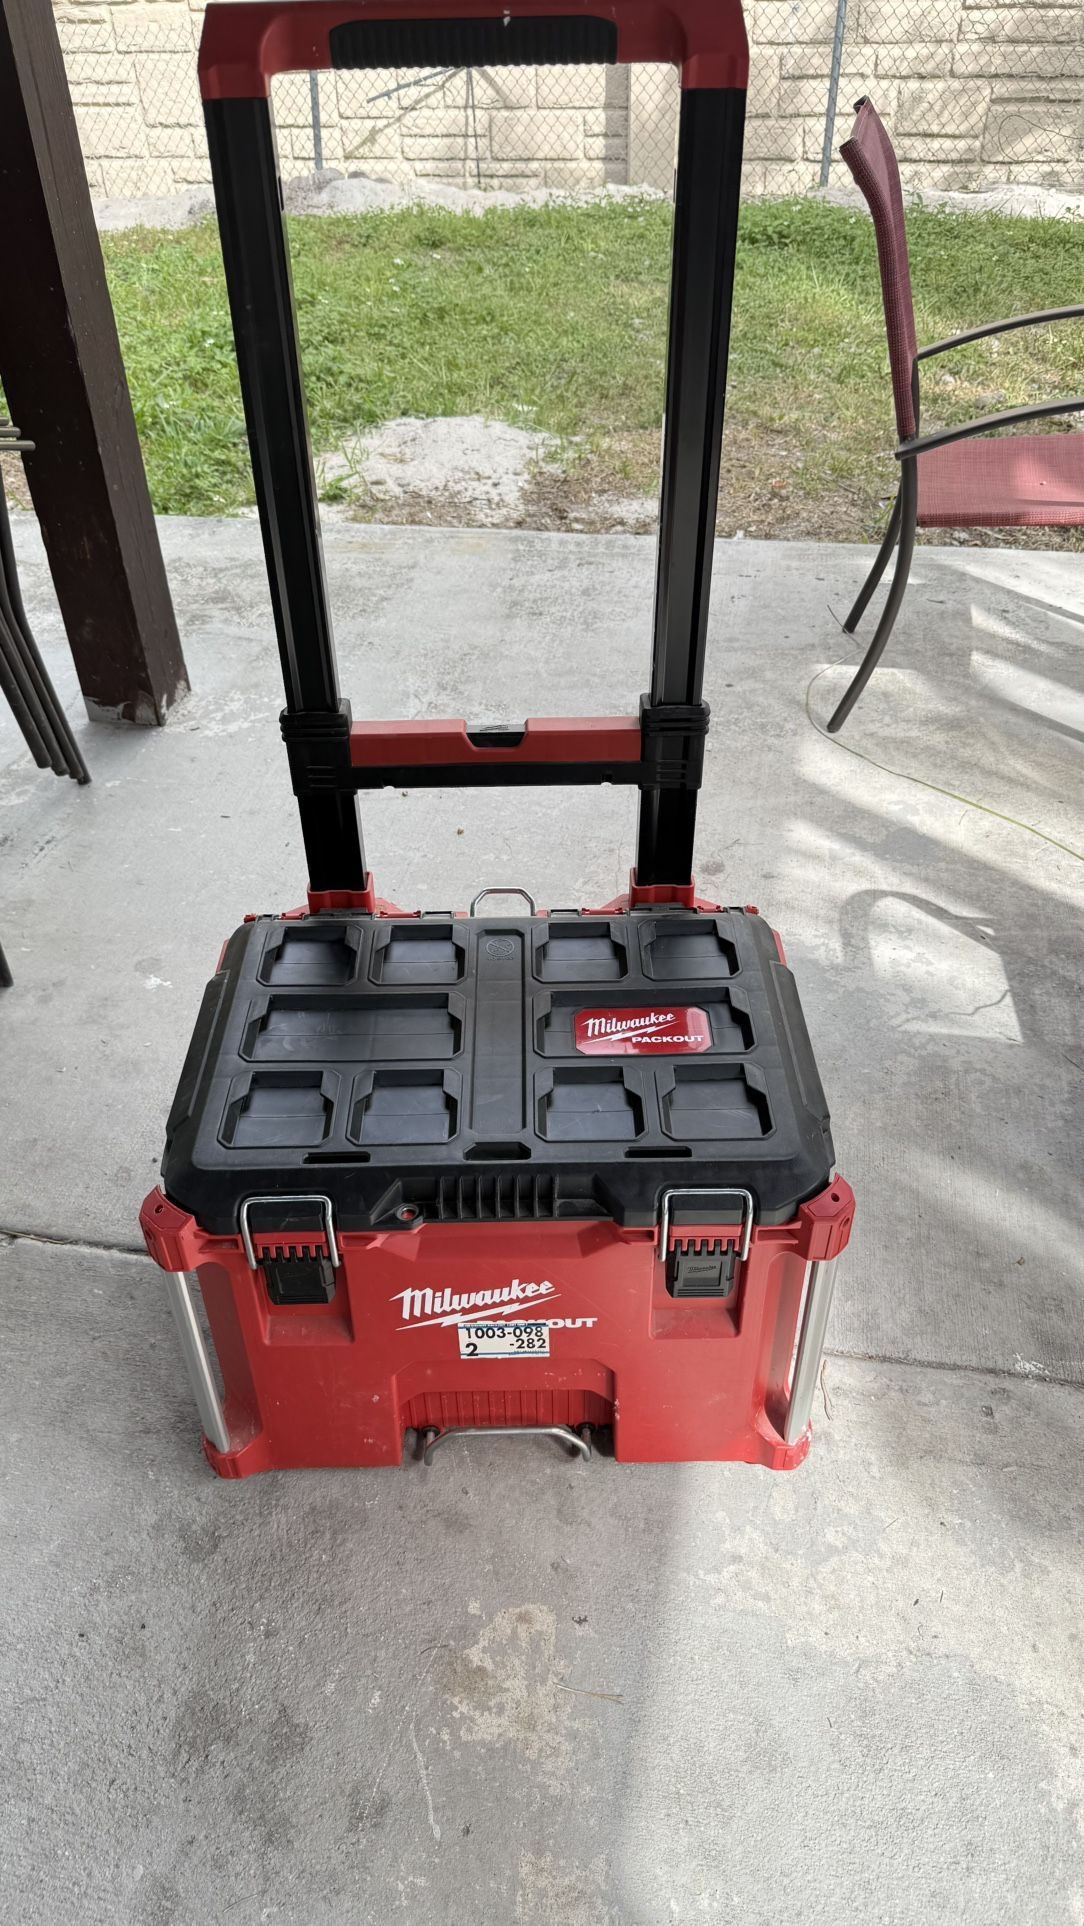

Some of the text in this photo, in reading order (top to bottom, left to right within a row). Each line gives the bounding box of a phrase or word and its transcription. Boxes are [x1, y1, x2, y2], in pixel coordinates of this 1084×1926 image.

[581, 1012, 676, 1037] Milwaukee
[631, 1035, 704, 1043] PACKOUT
[389, 1278, 555, 1320] Milwaukee
[465, 1325, 544, 1339] 1003-098
[465, 1342, 479, 1357] 2
[510, 1338, 546, 1349] -282
